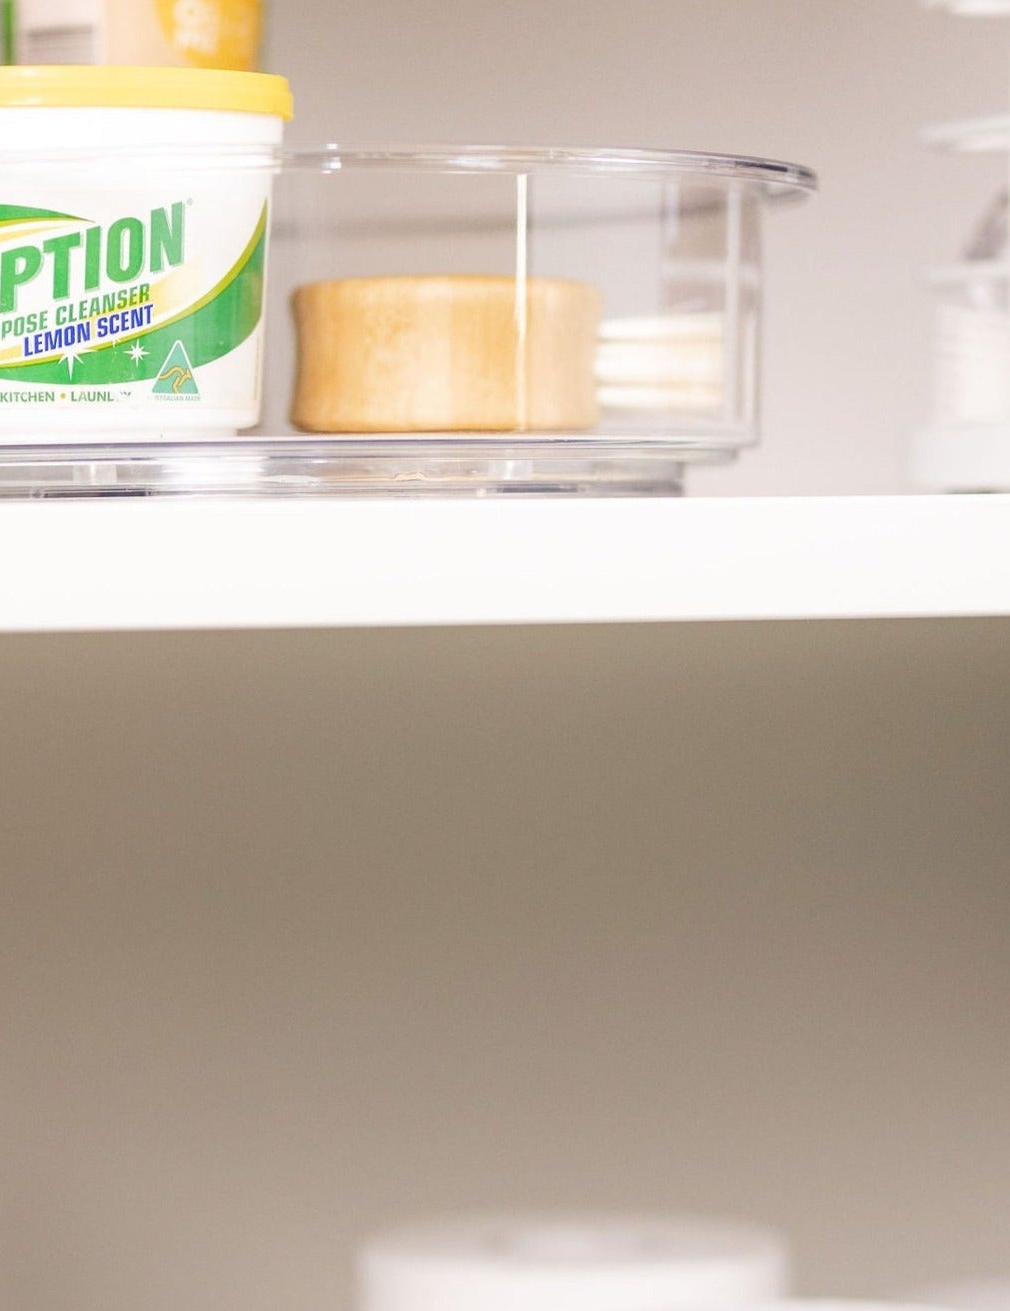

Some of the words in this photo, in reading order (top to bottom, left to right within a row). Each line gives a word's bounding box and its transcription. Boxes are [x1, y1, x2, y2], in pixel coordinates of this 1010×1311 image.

[55, 283, 150, 326] CLEANSER
[24, 322, 90, 357] LEMON
[97, 305, 153, 338] SCENT
[0, 391, 55, 402] KITCHEN
